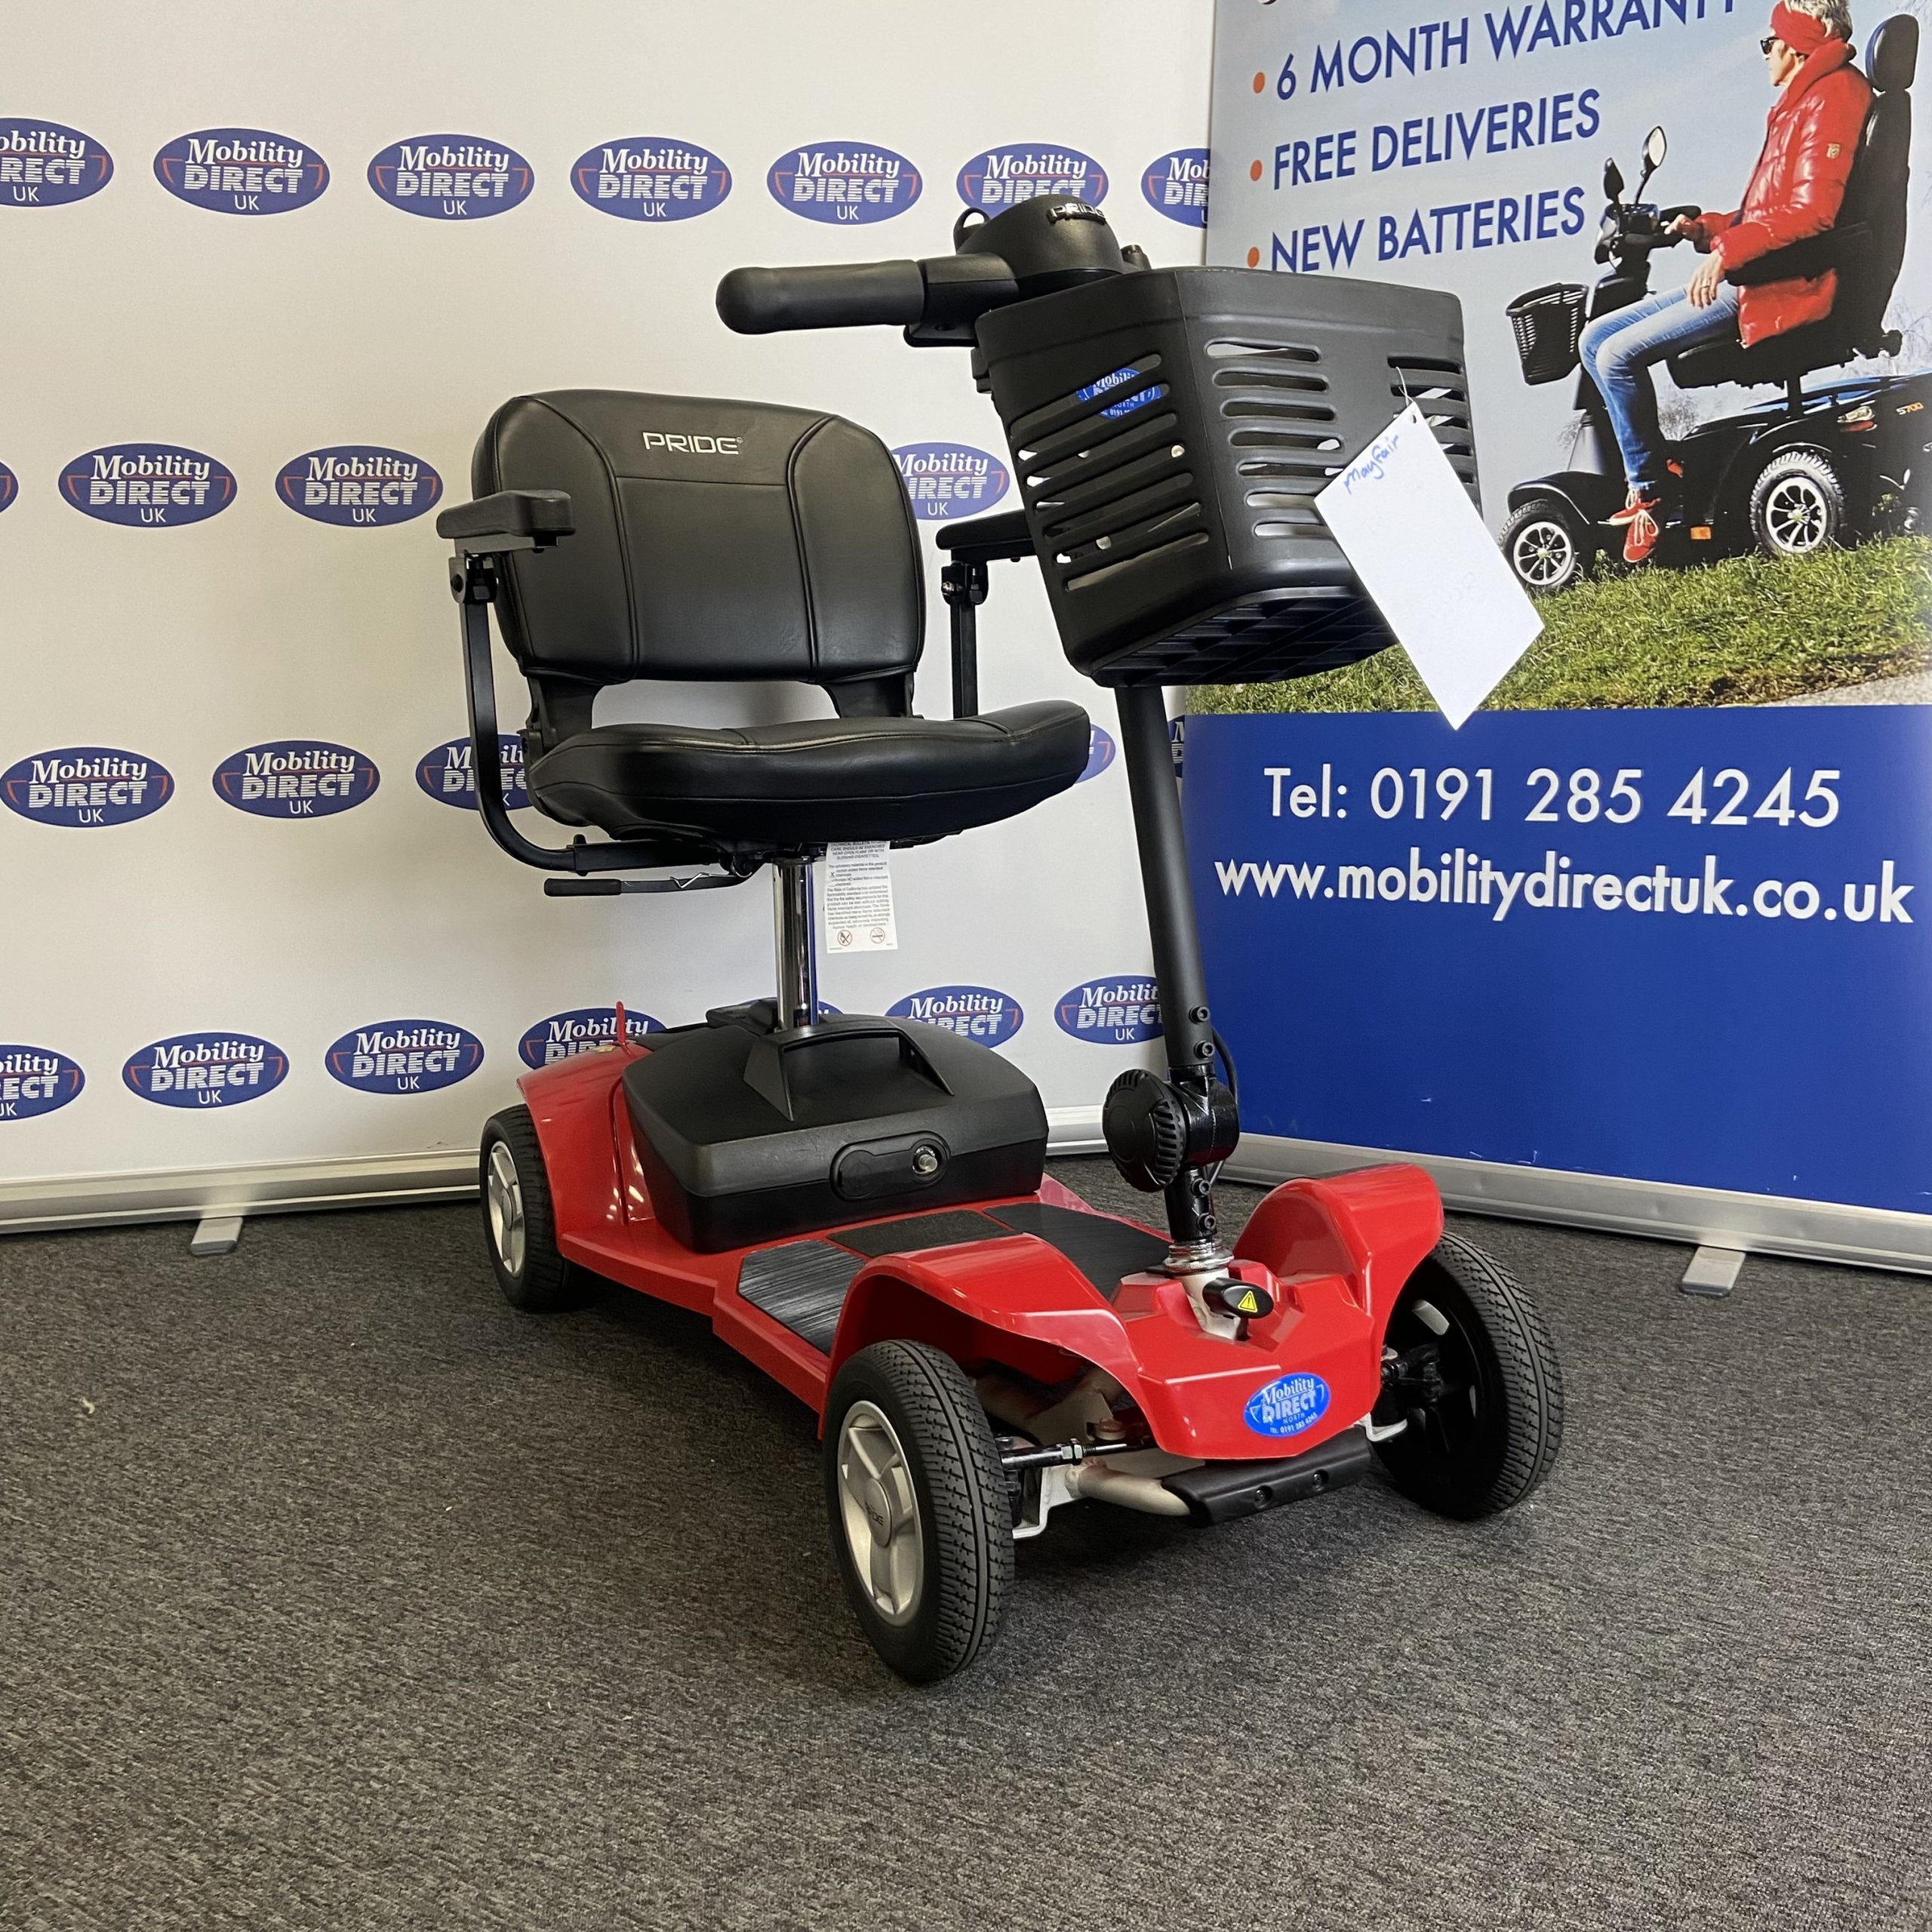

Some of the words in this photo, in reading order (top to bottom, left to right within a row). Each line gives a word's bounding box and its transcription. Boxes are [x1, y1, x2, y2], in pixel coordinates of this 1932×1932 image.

[1276, 53, 1297, 100] 6
[1310, 17, 1469, 94] MONTH
[1484, 0, 1734, 59] WARRAN
[0, 130, 85, 159] obility
[1273, 130, 1357, 190] FREE
[1371, 88, 1600, 172] DELIVERIES
[185, 138, 303, 169] Mobility
[397, 145, 510, 172] Mobility
[598, 148, 709, 174] Mobility
[794, 152, 901, 180] Mobility
[0, 157, 85, 184] RECT
[184, 165, 303, 193] DIRECT
[983, 154, 1087, 180] Mobility
[13, 186, 39, 202] UK
[395, 171, 509, 198] DIRECT
[597, 174, 708, 200] DIRECT
[792, 177, 900, 204] DIRECT
[234, 195, 260, 211] UK
[442, 200, 467, 215] UK
[643, 202, 666, 217] UK
[836, 205, 860, 220] UK
[1272, 219, 1365, 273] NEW
[1377, 186, 1585, 262] BATTERIES
[642, 432, 740, 455] PRIDE
[90, 454, 211, 480] Mobility
[306, 456, 419, 482] Mobility
[893, 453, 988, 476] Mobility
[89, 480, 211, 505] DIRECT
[305, 481, 418, 505] DIRECT
[906, 476, 987, 499] IRECT
[140, 507, 166, 523] UK
[352, 508, 377, 523] UK
[927, 502, 949, 515] UK
[30, 757, 147, 785] Mobility
[244, 750, 355, 774] Mobility
[28, 782, 147, 808] DIRECT
[242, 772, 355, 799] DIRECT
[1264, 763, 1347, 819] Tel:
[1371, 768, 1492, 820] 0191
[1524, 768, 1642, 823] 285
[1666, 767, 1841, 828] 4245
[78, 808, 104, 823] UK
[289, 799, 314, 814] UK
[1214, 847, 1915, 924] www.mobilitydirectuk.co.uk
[907, 994, 1003, 1019] Mobility
[1078, 983, 1159, 1008] Mobilit
[1076, 1004, 1163, 1029] DIREC
[353, 1028, 461, 1055] Mobility
[546, 1017, 649, 1043] Mobilty
[1115, 1028, 1135, 1041] UK
[0, 1053, 59, 1075] ility
[151, 1041, 264, 1069] Mobility
[352, 1049, 460, 1078] DIRECT
[0, 1075, 59, 1100] ECT
[151, 1063, 264, 1091] DIRECT
[397, 1075, 420, 1091] UK
[198, 1090, 223, 1104] UK
[1261, 1378, 1314, 1405] Mobility
[1261, 1390, 1316, 1423] DIRECT
